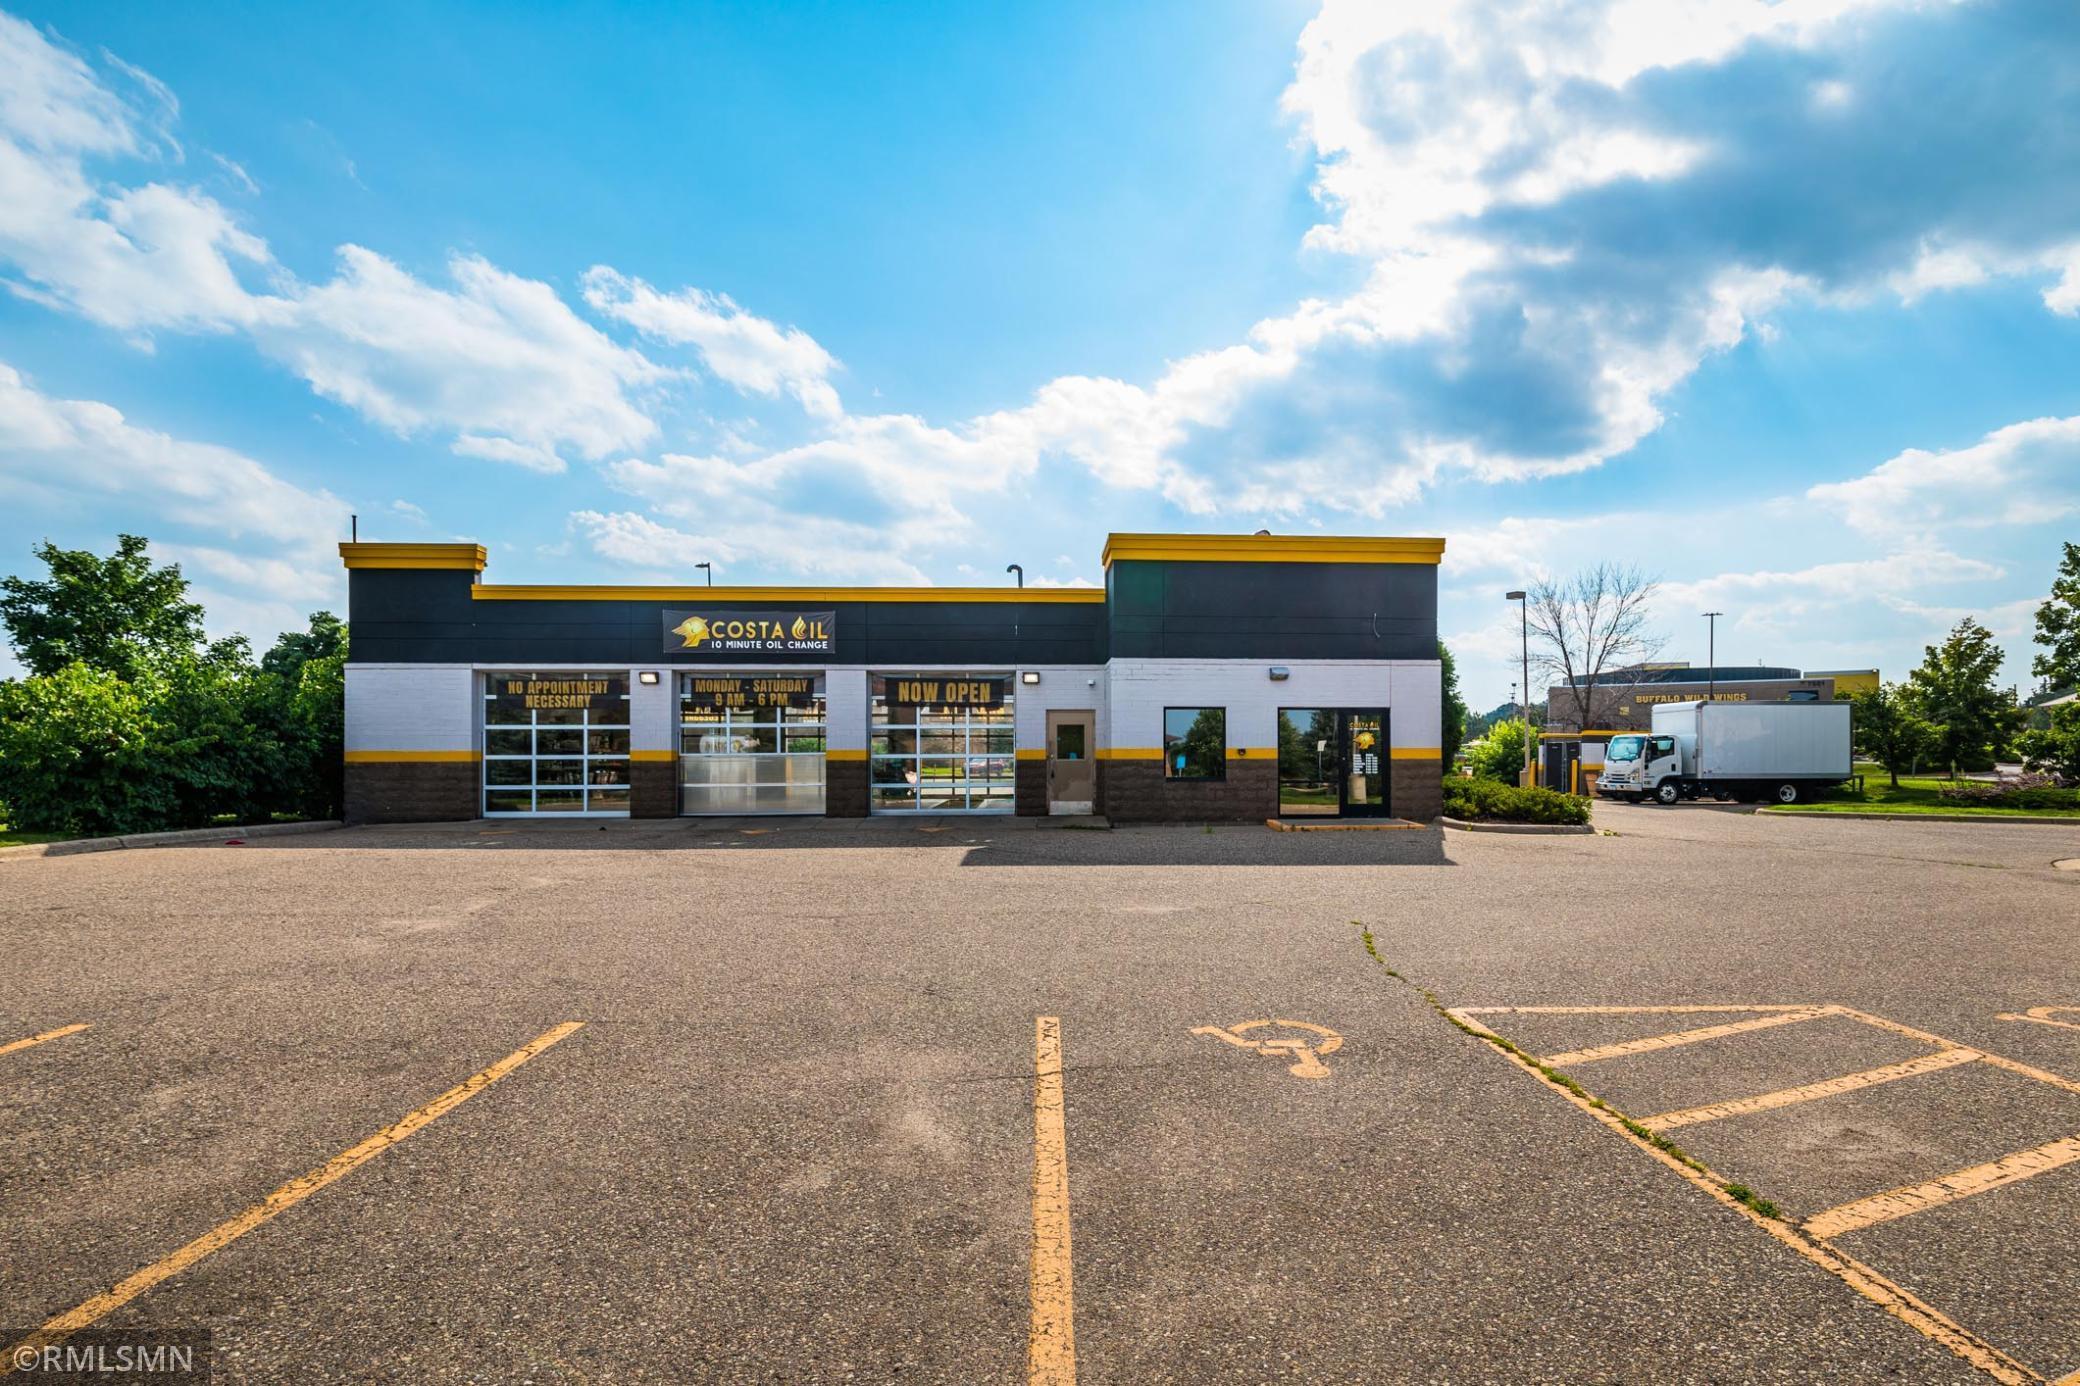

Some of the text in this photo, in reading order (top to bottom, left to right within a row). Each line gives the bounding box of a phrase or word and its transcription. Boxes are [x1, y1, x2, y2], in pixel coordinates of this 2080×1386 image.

[711, 620, 785, 639] COSTA
[711, 641, 828, 649] 10 MINUTE OIL CHANGE
[508, 681, 609, 695] NO APPOINTMENT
[695, 680, 741, 693] MONDAY
[753, 680, 808, 693] SATURDAY
[898, 681, 991, 703] NOW OPEN
[525, 694, 592, 708] NECESSARY
[715, 693, 723, 706] 9
[727, 693, 745, 706] AM
[758, 693, 766, 706] 6
[769, 693, 789, 706] PM
[1635, 693, 1747, 703] BUFFALO WILD WINGS
